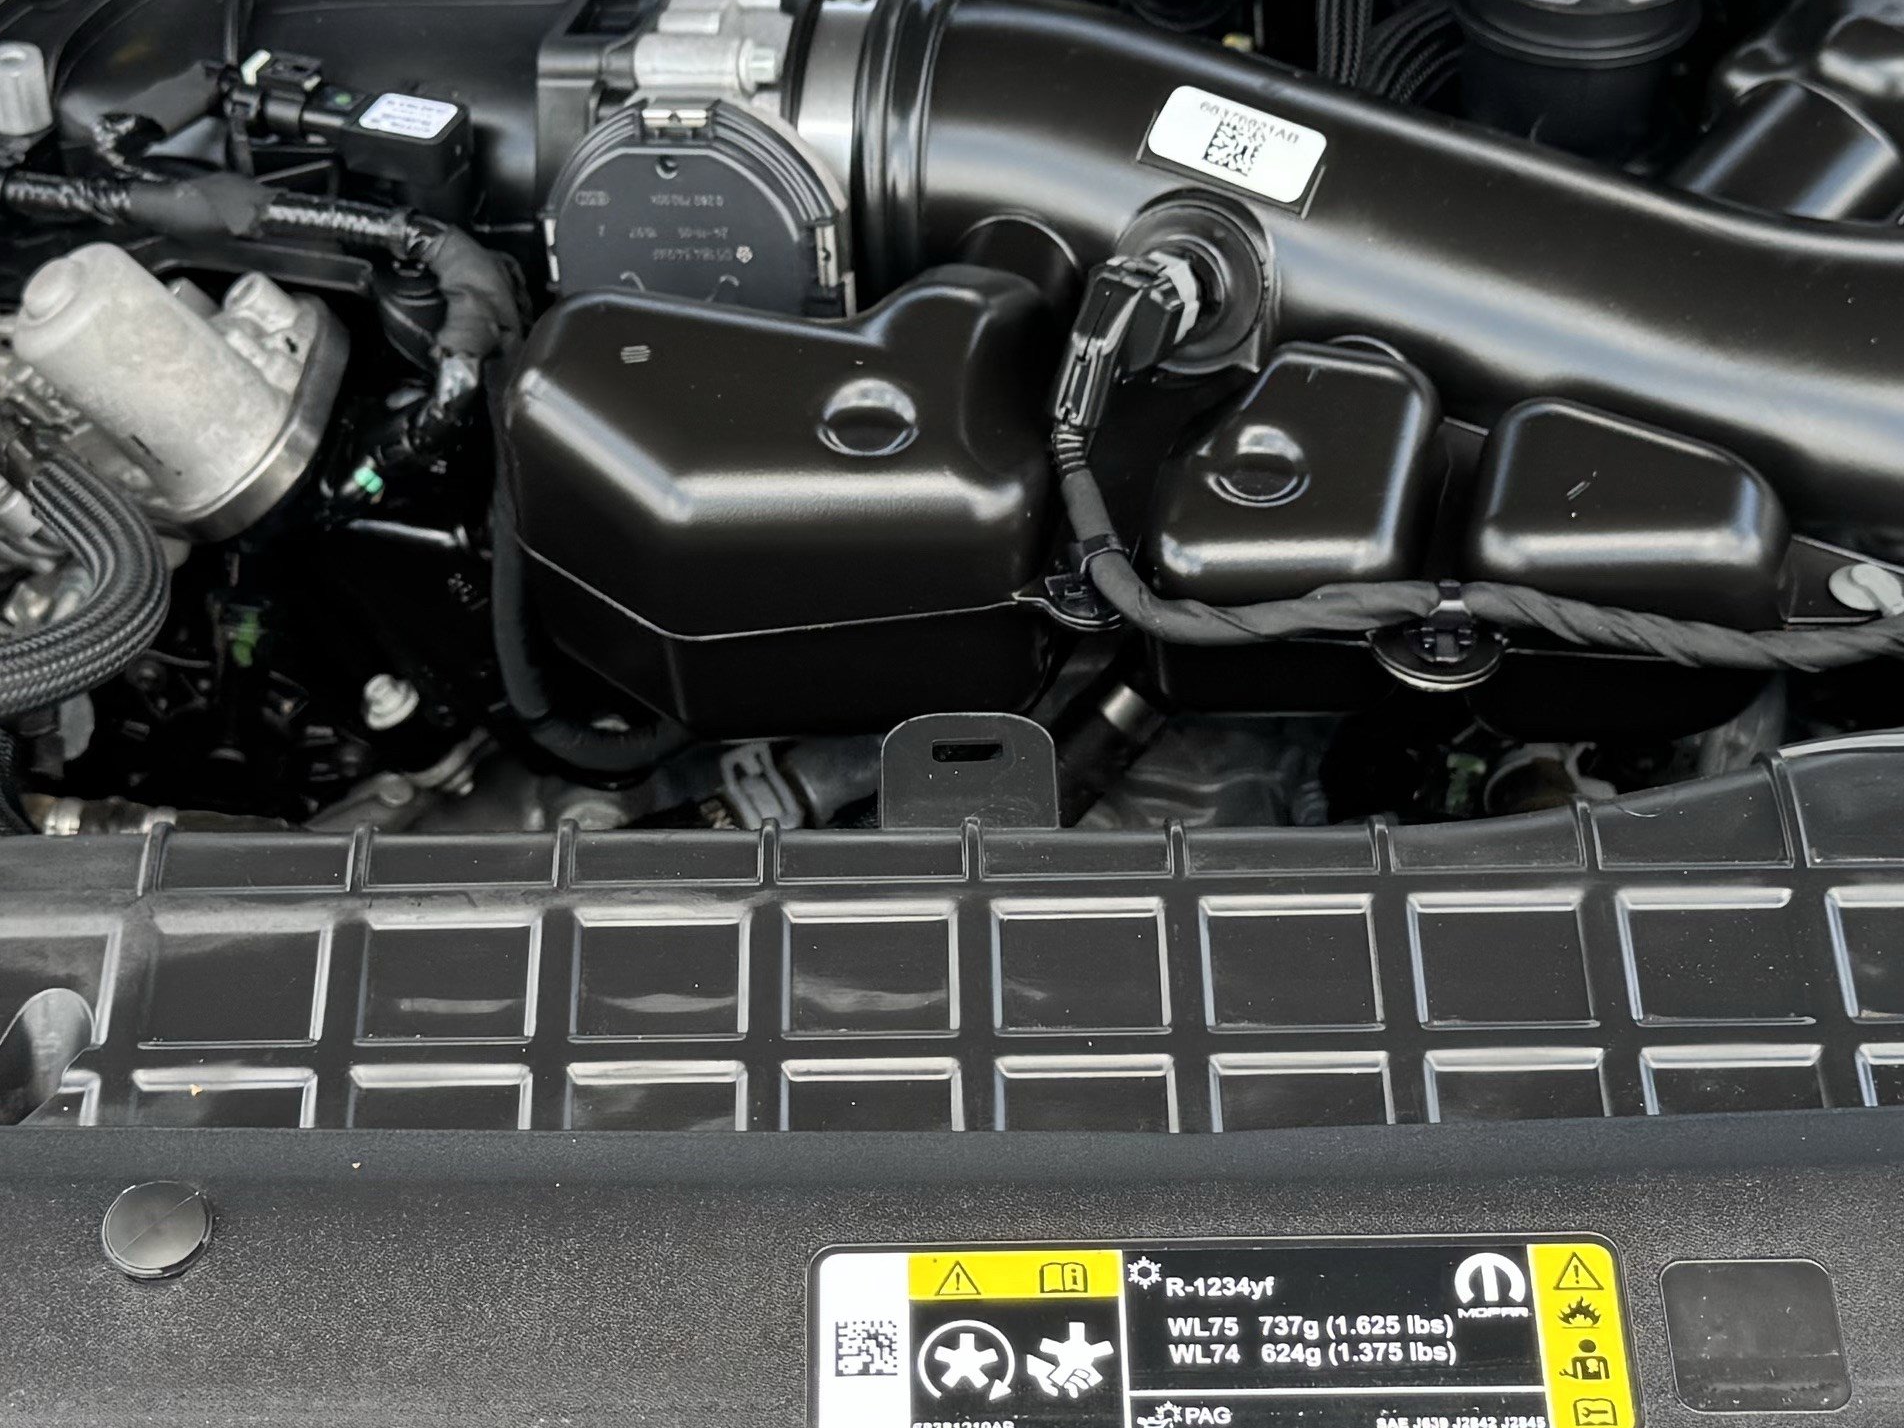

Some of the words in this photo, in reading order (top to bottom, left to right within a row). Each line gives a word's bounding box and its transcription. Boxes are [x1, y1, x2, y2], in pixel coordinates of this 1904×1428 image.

[1165, 1276, 1276, 1300] R-1234yf
[1457, 1306, 1529, 1319] MOPAR
[1167, 1316, 1240, 1337] WL75
[1258, 1315, 1321, 1340] 737g
[1325, 1314, 1400, 1340] (1.625
[1406, 1314, 1455, 1339] lbs)
[1168, 1343, 1241, 1364] WL74
[1261, 1342, 1322, 1367] 624g
[1328, 1342, 1403, 1366] (1.375
[1409, 1341, 1458, 1366] lbs)
[1184, 1406, 1232, 1425] PAG
